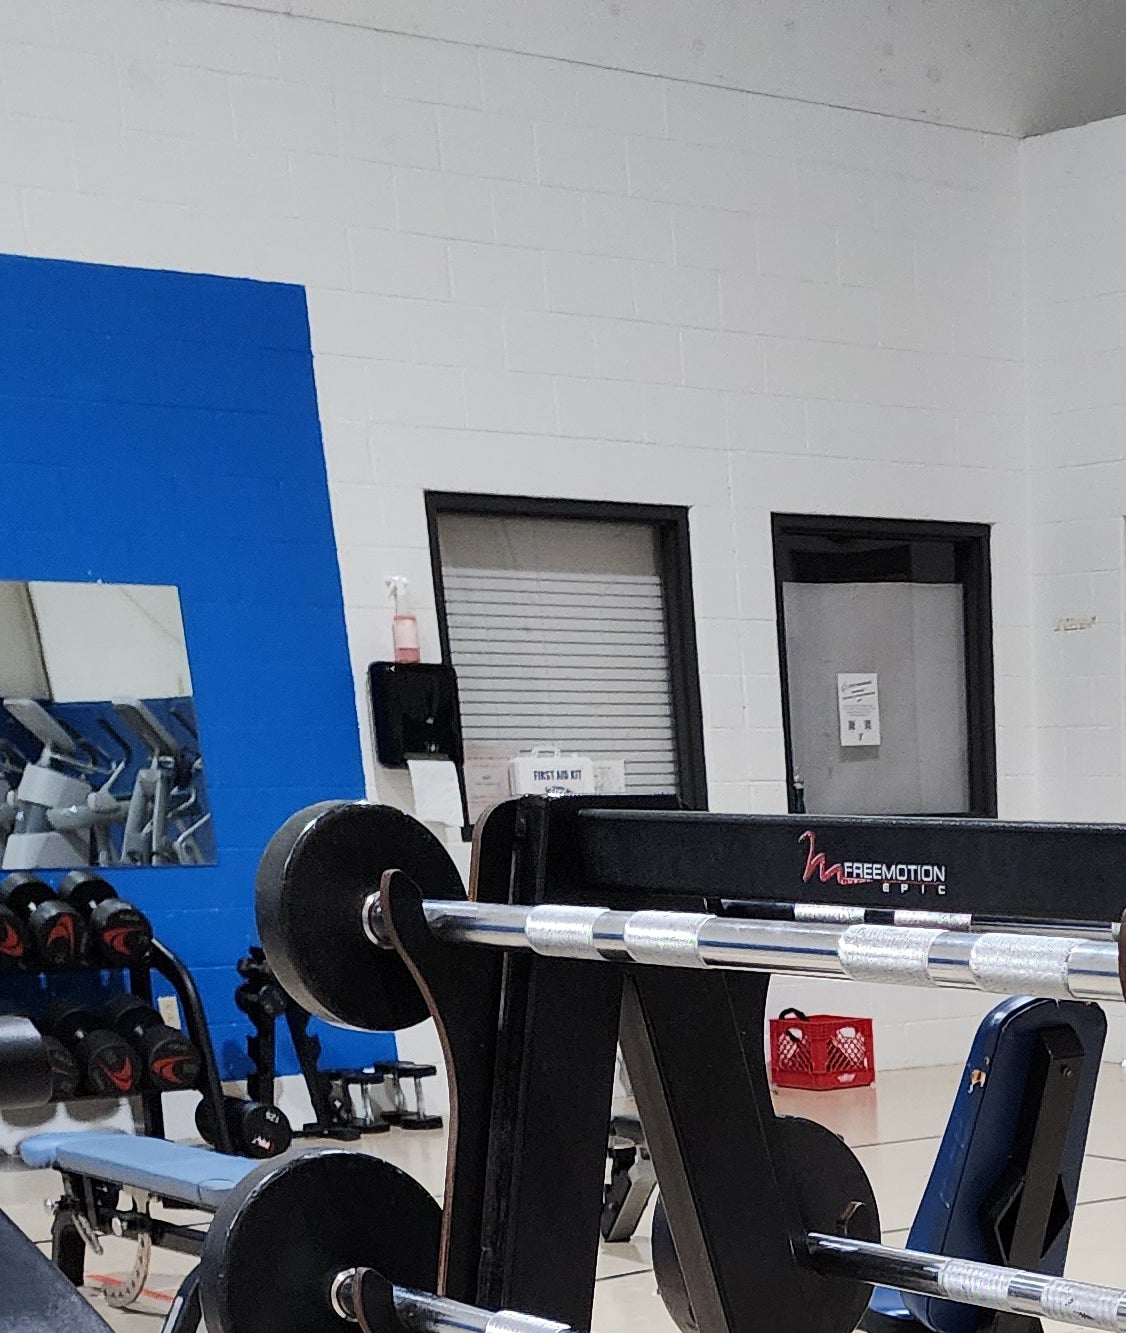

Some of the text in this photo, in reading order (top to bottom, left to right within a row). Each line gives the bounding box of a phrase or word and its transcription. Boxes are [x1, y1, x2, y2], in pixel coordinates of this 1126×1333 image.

[533, 769, 554, 781] FIRST
[556, 769, 569, 781] AID
[571, 769, 582, 781] KIT
[843, 861, 946, 882] FREEMOTION
[882, 882, 946, 895] EPIC
